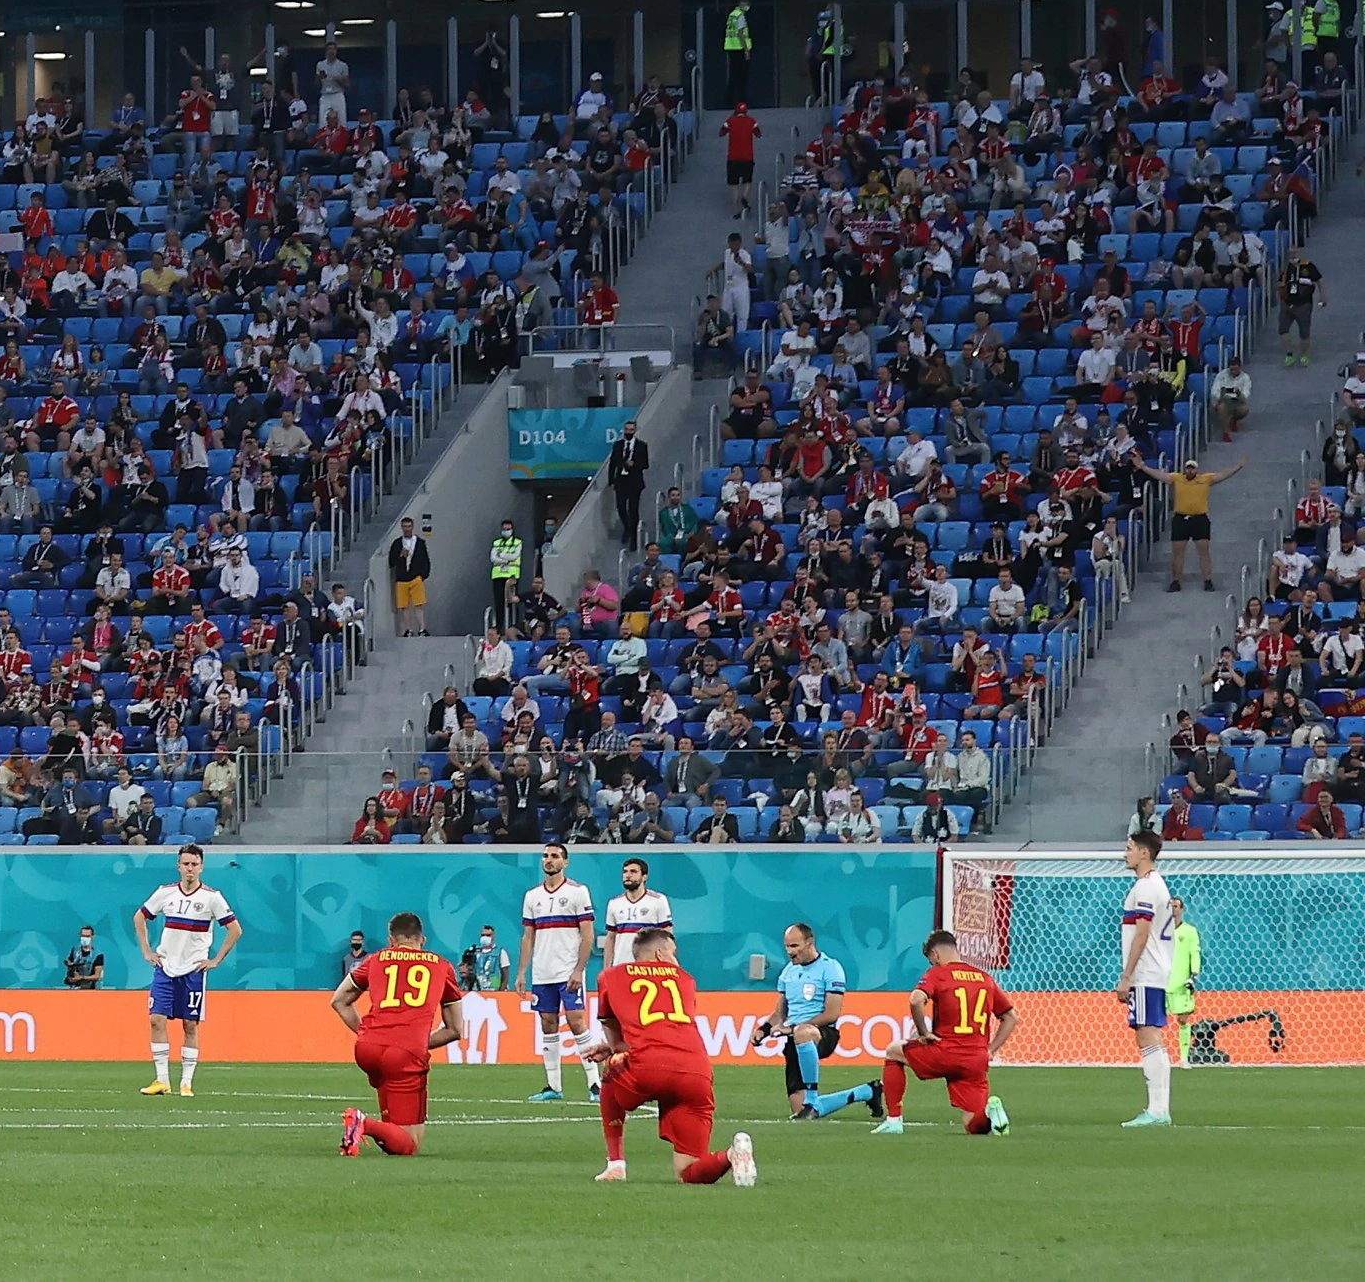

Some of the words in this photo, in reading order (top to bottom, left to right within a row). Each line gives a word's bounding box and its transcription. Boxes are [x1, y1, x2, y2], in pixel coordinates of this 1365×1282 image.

[519, 429, 568, 446] D104
[176, 899, 192, 915] 17
[548, 897, 555, 914] 7
[379, 950, 440, 964] DENDONCKER
[626, 964, 680, 978] CASTAGNE
[379, 964, 431, 1009] 19
[187, 991, 203, 1008] 17
[630, 978, 692, 1027] 21
[953, 986, 988, 1036] 14
